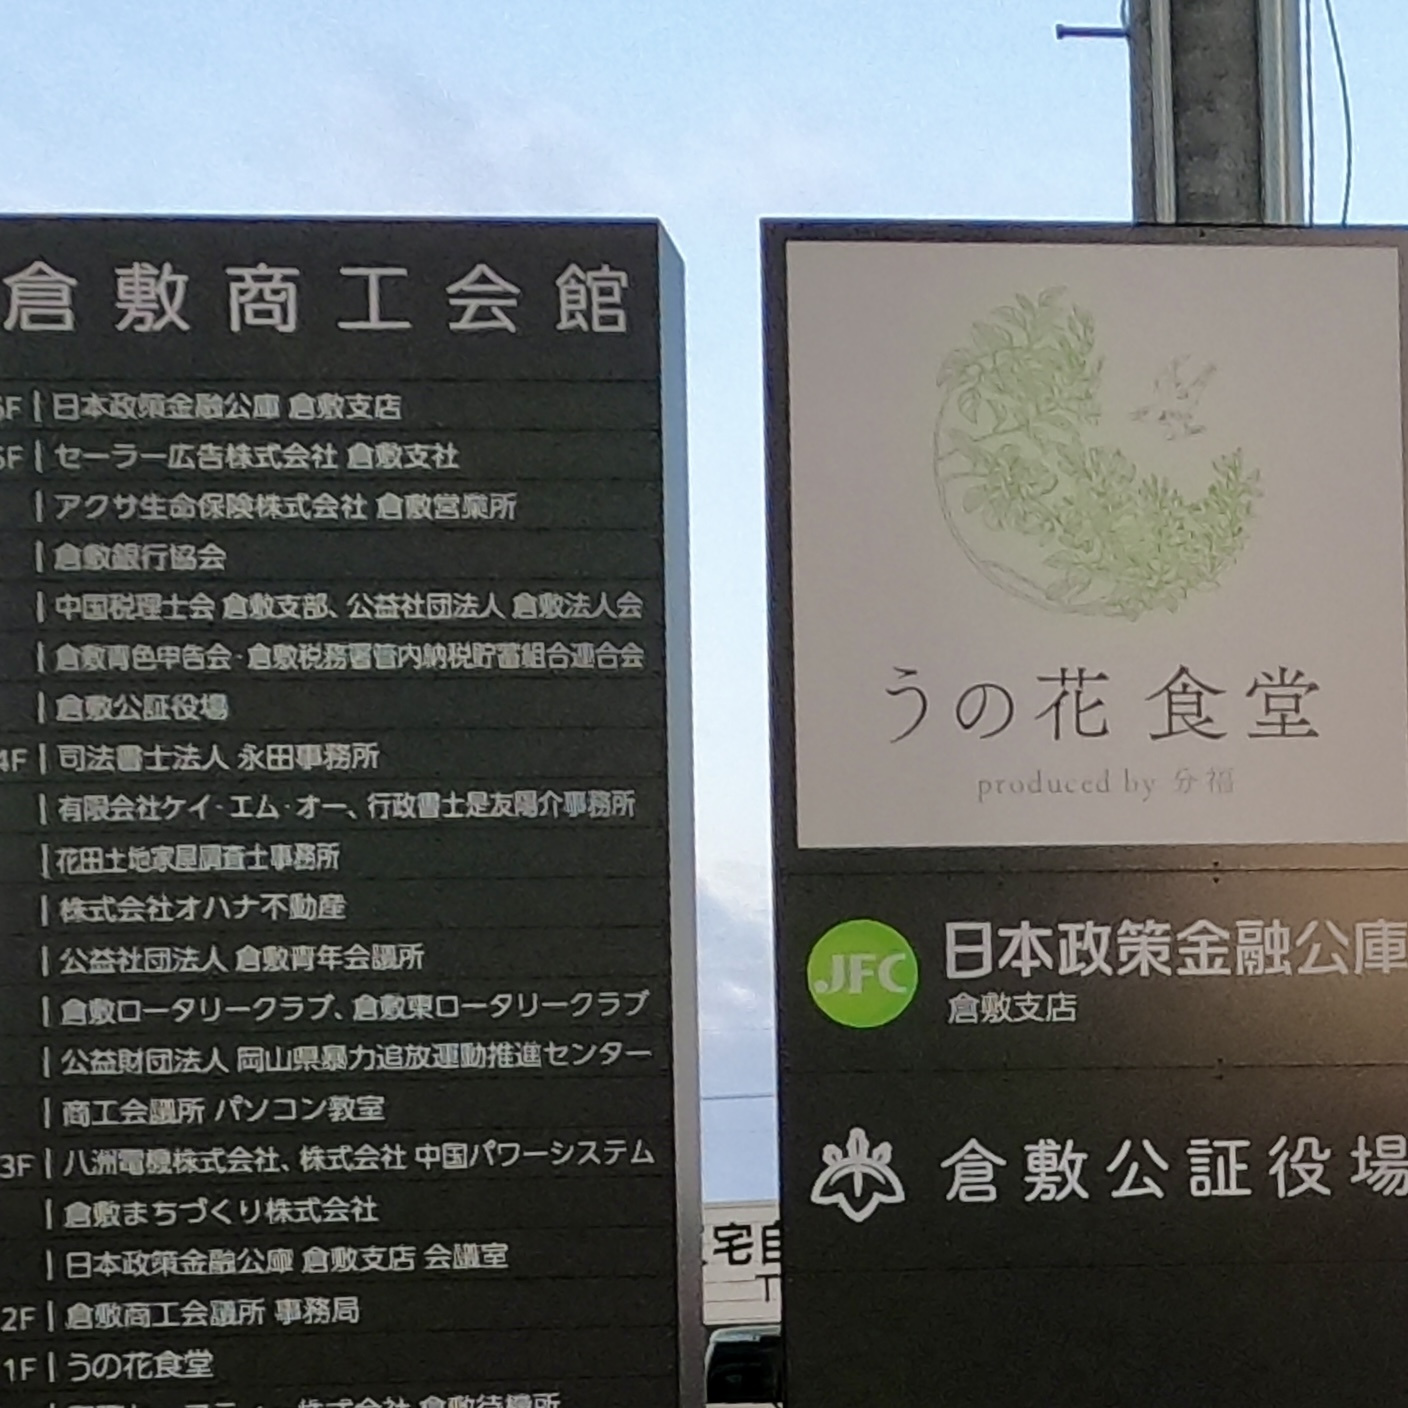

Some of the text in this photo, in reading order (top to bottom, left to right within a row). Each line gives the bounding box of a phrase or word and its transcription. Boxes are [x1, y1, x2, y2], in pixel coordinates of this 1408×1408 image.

[3, 261, 628, 333] 倉敷商工会館
[288, 392, 402, 421] 倉敷支店
[54, 442, 339, 470] セーラー広告株式会社
[347, 441, 460, 470] 倉敷支社
[55, 492, 517, 520] アクサ生命保険株式会社 倉敷営業所
[54, 542, 227, 572] 倉敷銀行協会
[55, 592, 216, 621] 中国税理士会
[511, 591, 643, 620] 倉敷法人会
[55, 693, 229, 722] 倉敷公証役場
[57, 743, 230, 772] 司法書士法人
[237, 742, 380, 771] 永田事務所
[978, 769, 1109, 803] produced
[1124, 768, 1155, 802] by
[60, 892, 347, 923] 株式会社オハナ不動産
[59, 946, 229, 974] 公益社団法人
[815, 950, 909, 996] JFC
[948, 991, 1077, 1024] 倉敷支店
[61, 1047, 230, 1075] 公益財団法人
[62, 1094, 386, 1128] 商工会議所 パソコン教室
[0, 1154, 35, 1179] 3F
[414, 1139, 655, 1170] 中国パワーシステム
[63, 1195, 379, 1228] 倉敷まちづくり株式会社
[66, 1242, 509, 1279] 日本政策金融公庫 倉敷支店 会議室
[0, 1296, 360, 1332] 2F 倉敷商工会議所 事務局
[4, 1348, 214, 1382] 1F うの花食堂
